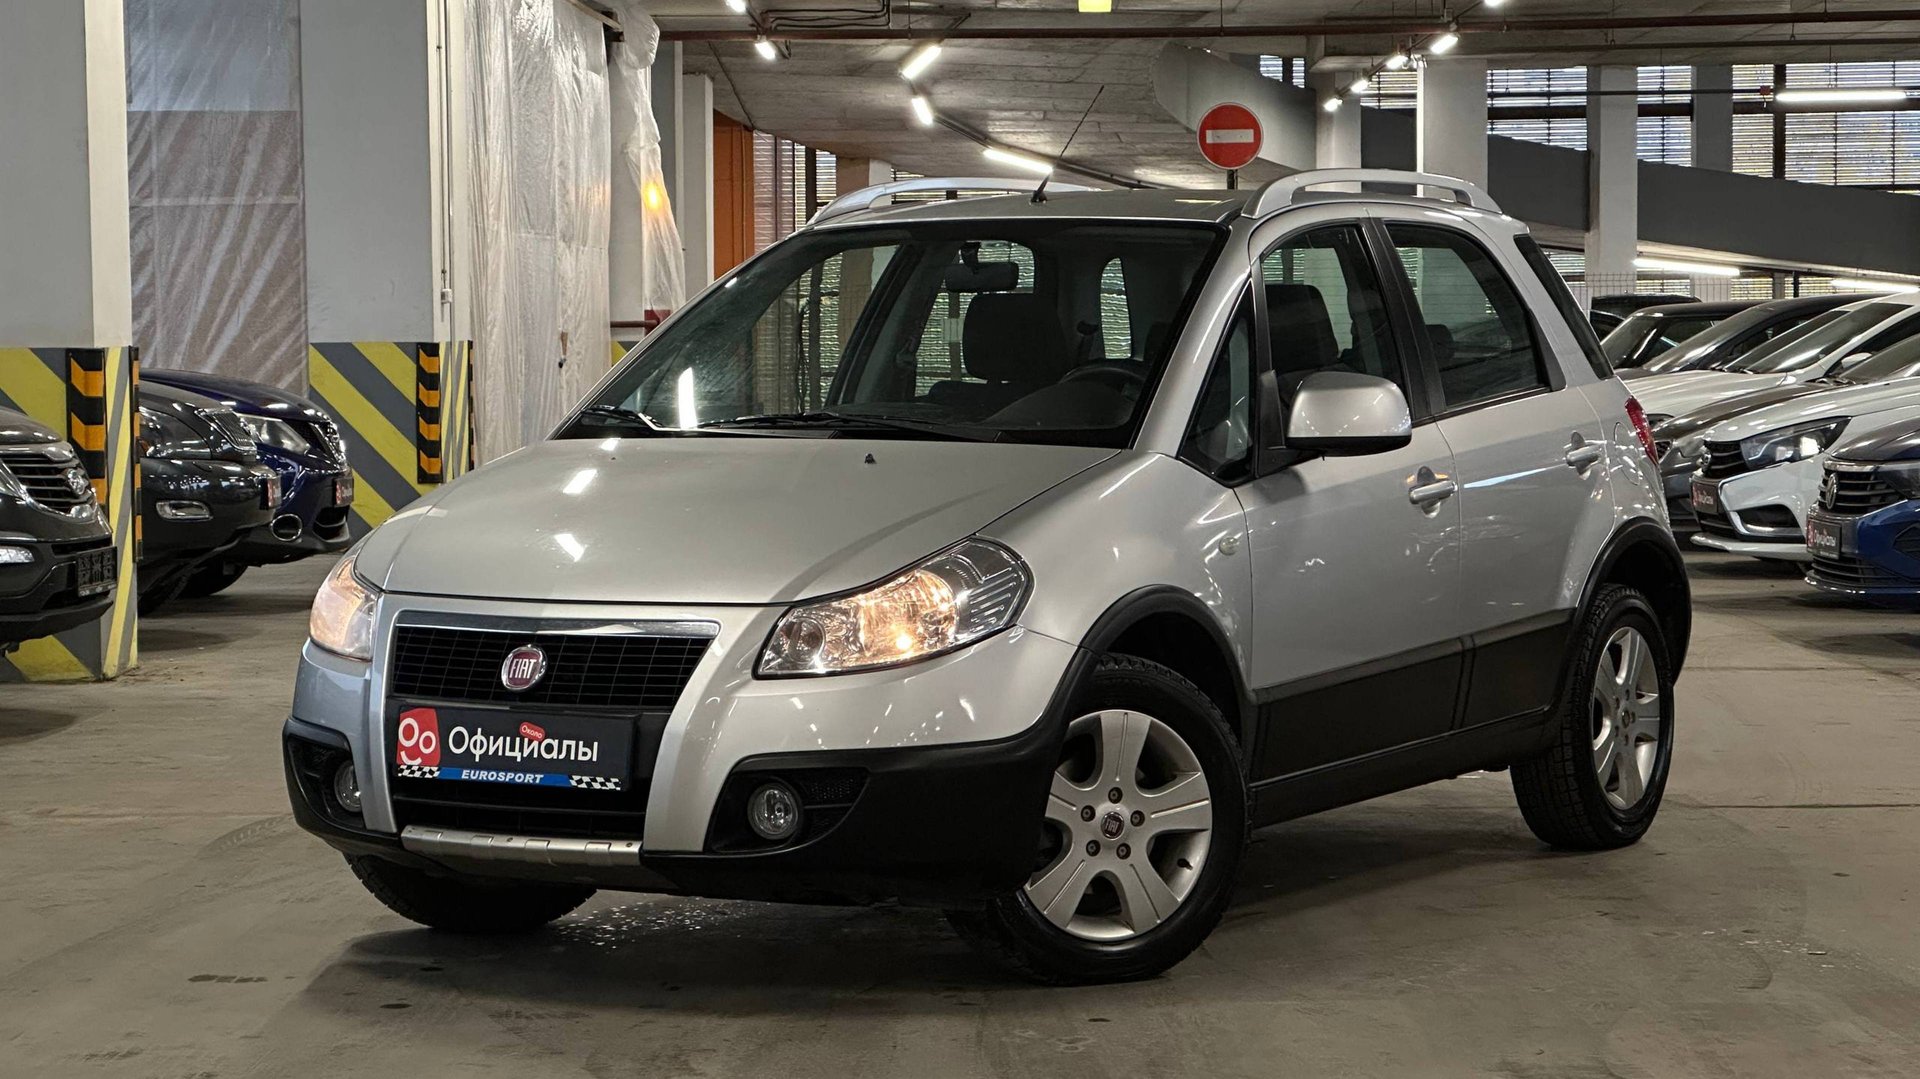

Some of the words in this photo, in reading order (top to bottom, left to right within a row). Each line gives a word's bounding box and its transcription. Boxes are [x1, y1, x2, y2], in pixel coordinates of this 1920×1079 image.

[509, 658, 537, 679] FIAT
[521, 724, 544, 739] Около
[448, 725, 599, 762] Официалы
[461, 769, 544, 784] EUROSPORT
[1105, 818, 1120, 833] FIAT
